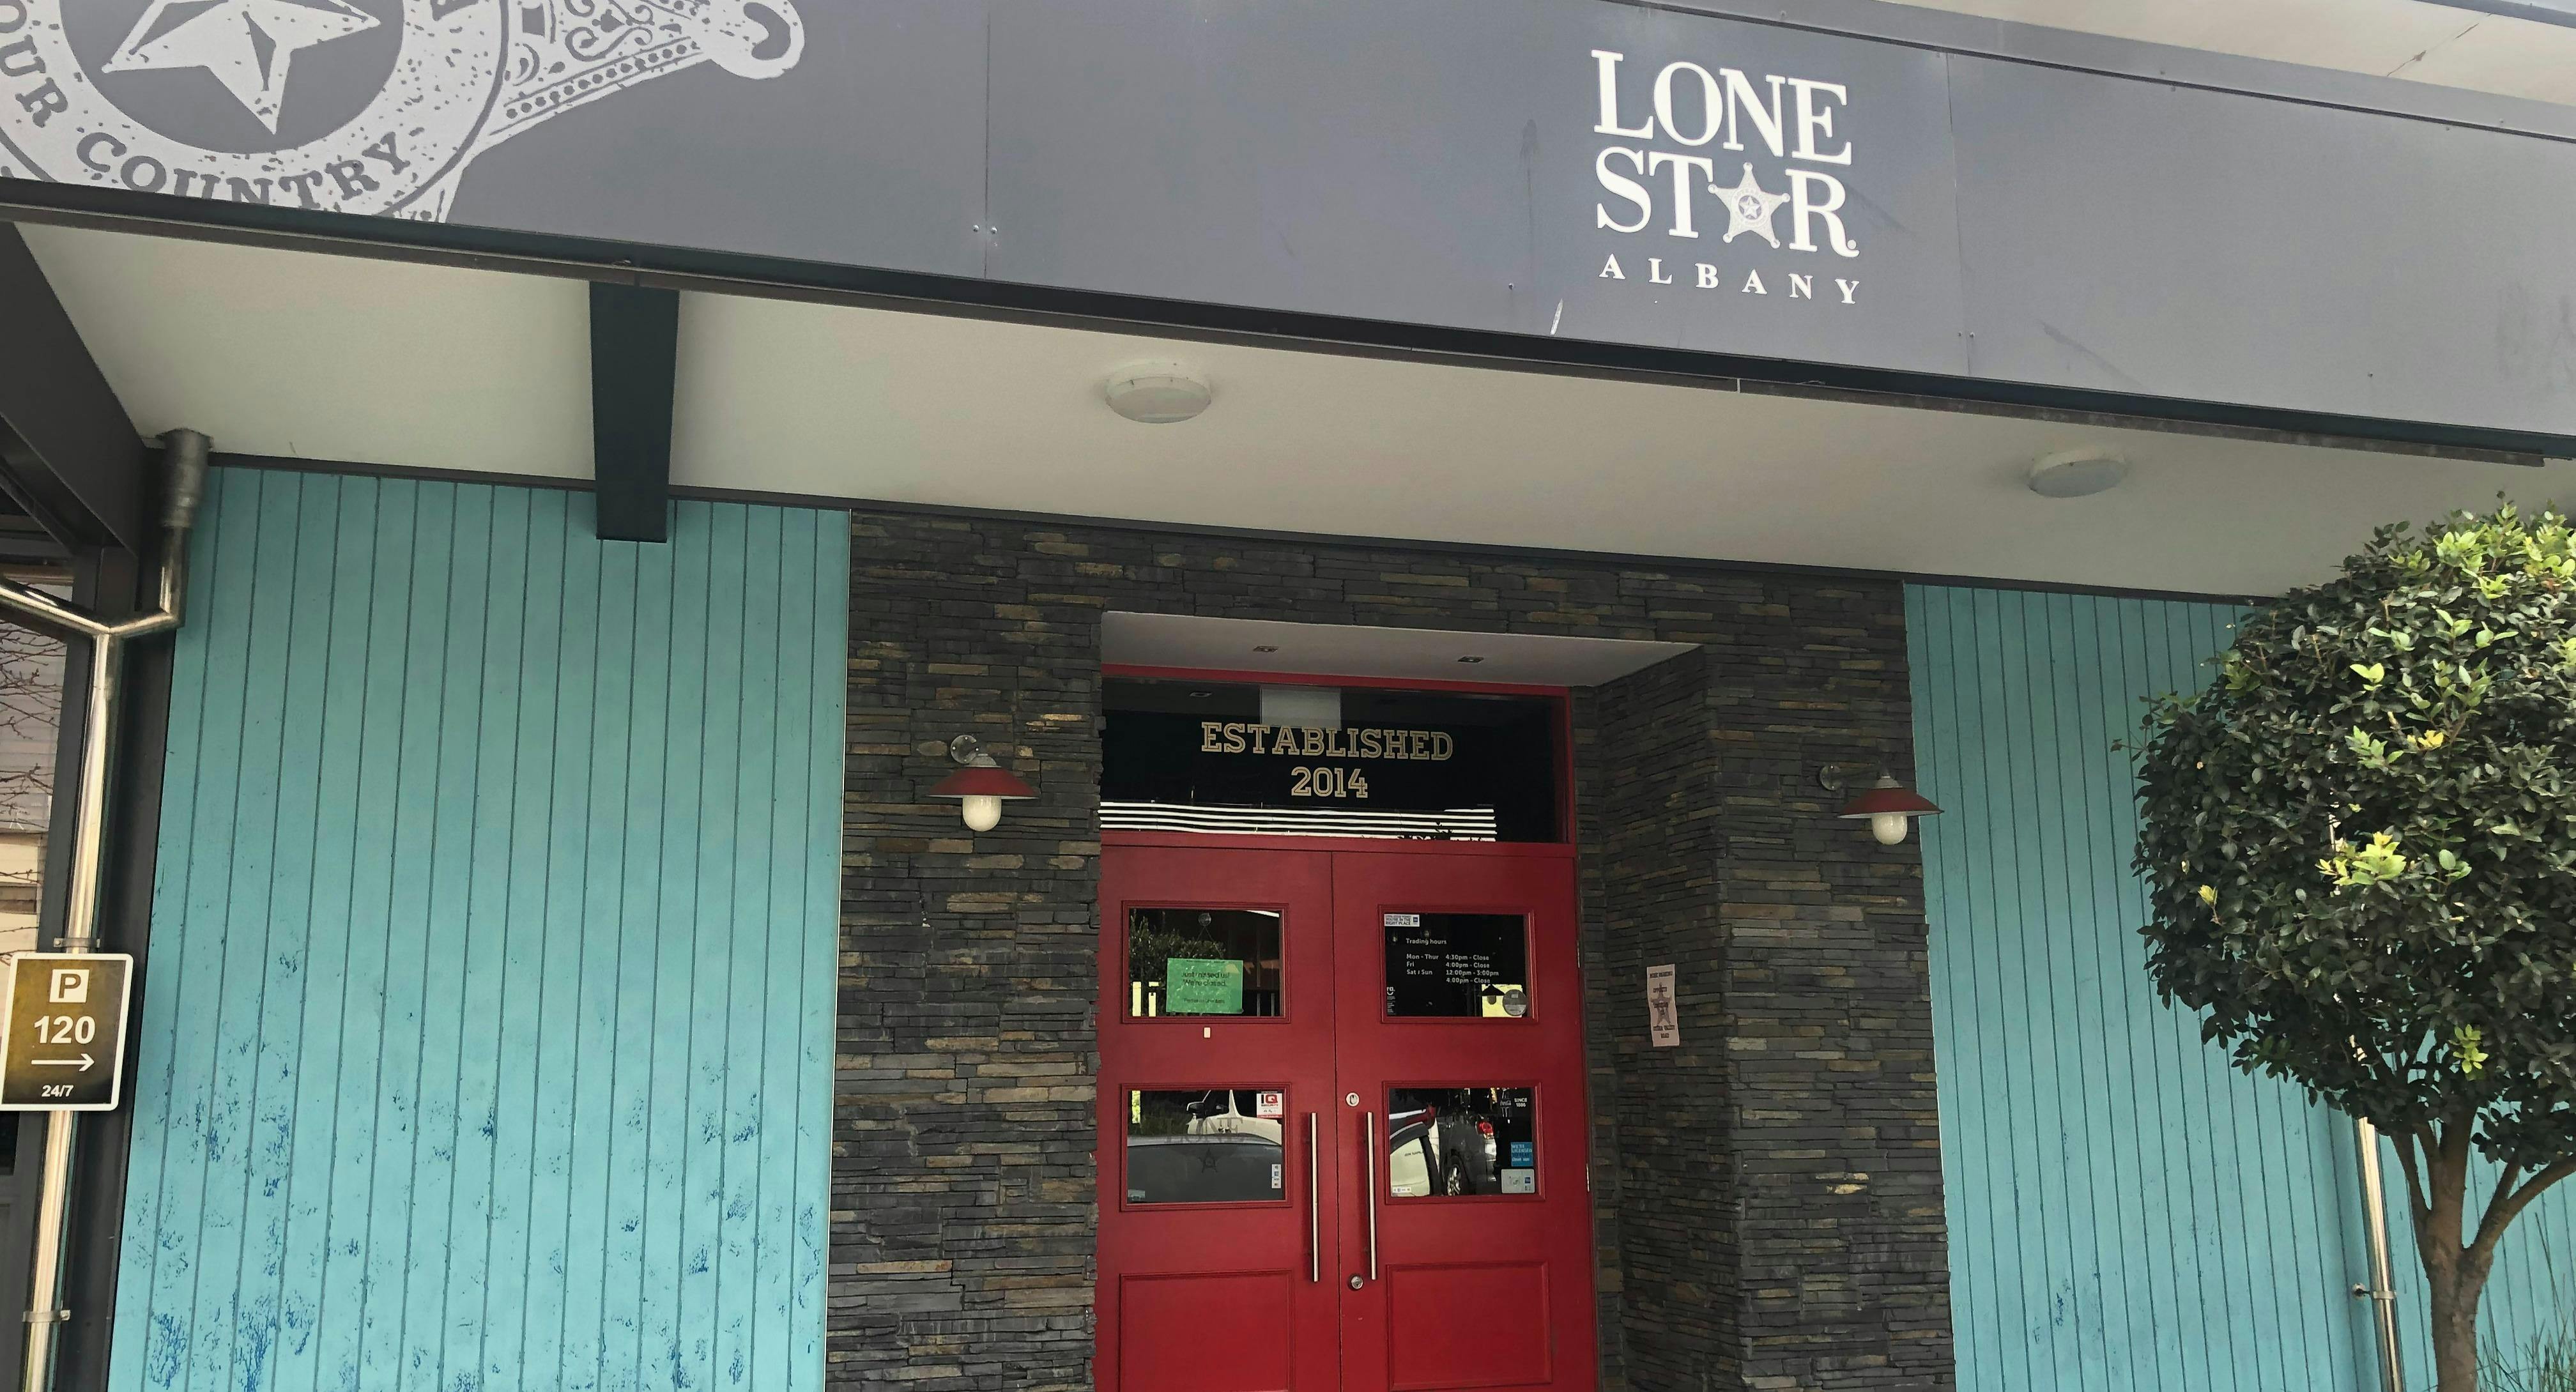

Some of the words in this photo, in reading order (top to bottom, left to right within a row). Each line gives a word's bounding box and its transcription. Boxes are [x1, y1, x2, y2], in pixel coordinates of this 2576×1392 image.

[1591, 49, 1853, 166] LONE
[76, 131, 410, 210] COUNTRY
[1599, 254, 1860, 305] ALBANY
[1201, 721, 1453, 761] ESTABLISHED
[1291, 767, 1368, 799] 2014
[58, 973, 81, 999] P
[34, 1016, 96, 1044] 120
[41, 1084, 74, 1098] 24/7
[1261, 1094, 1278, 1104] IQ
